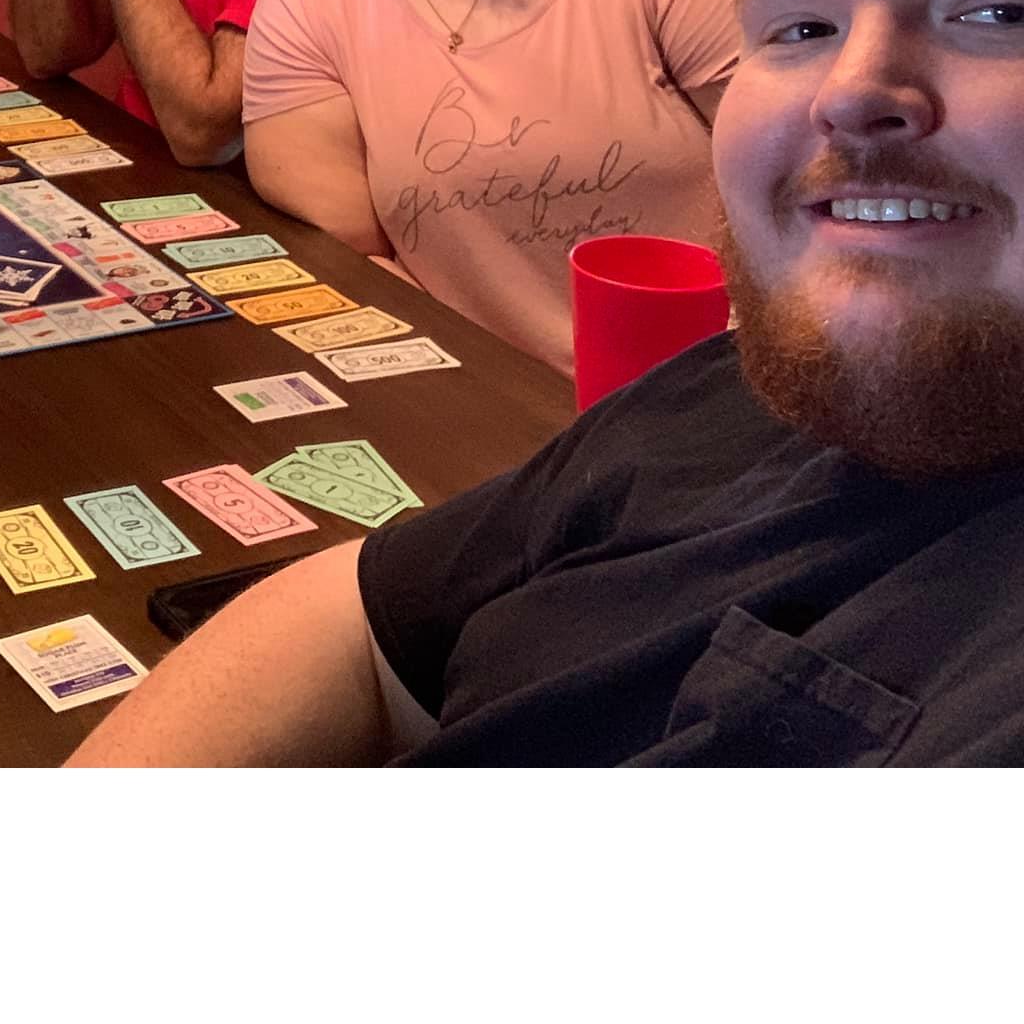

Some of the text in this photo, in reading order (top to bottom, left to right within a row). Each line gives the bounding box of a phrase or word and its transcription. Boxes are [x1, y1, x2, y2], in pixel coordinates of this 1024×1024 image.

[398, 139, 647, 254] grateful
[241, 272, 261, 281] 20
[282, 300, 304, 311] 50
[332, 323, 360, 335] 100
[370, 353, 402, 366] 500
[325, 484, 339, 495] 1
[223, 498, 246, 508] 5
[119, 518, 145, 532] 10
[14, 540, 39, 556] 20
